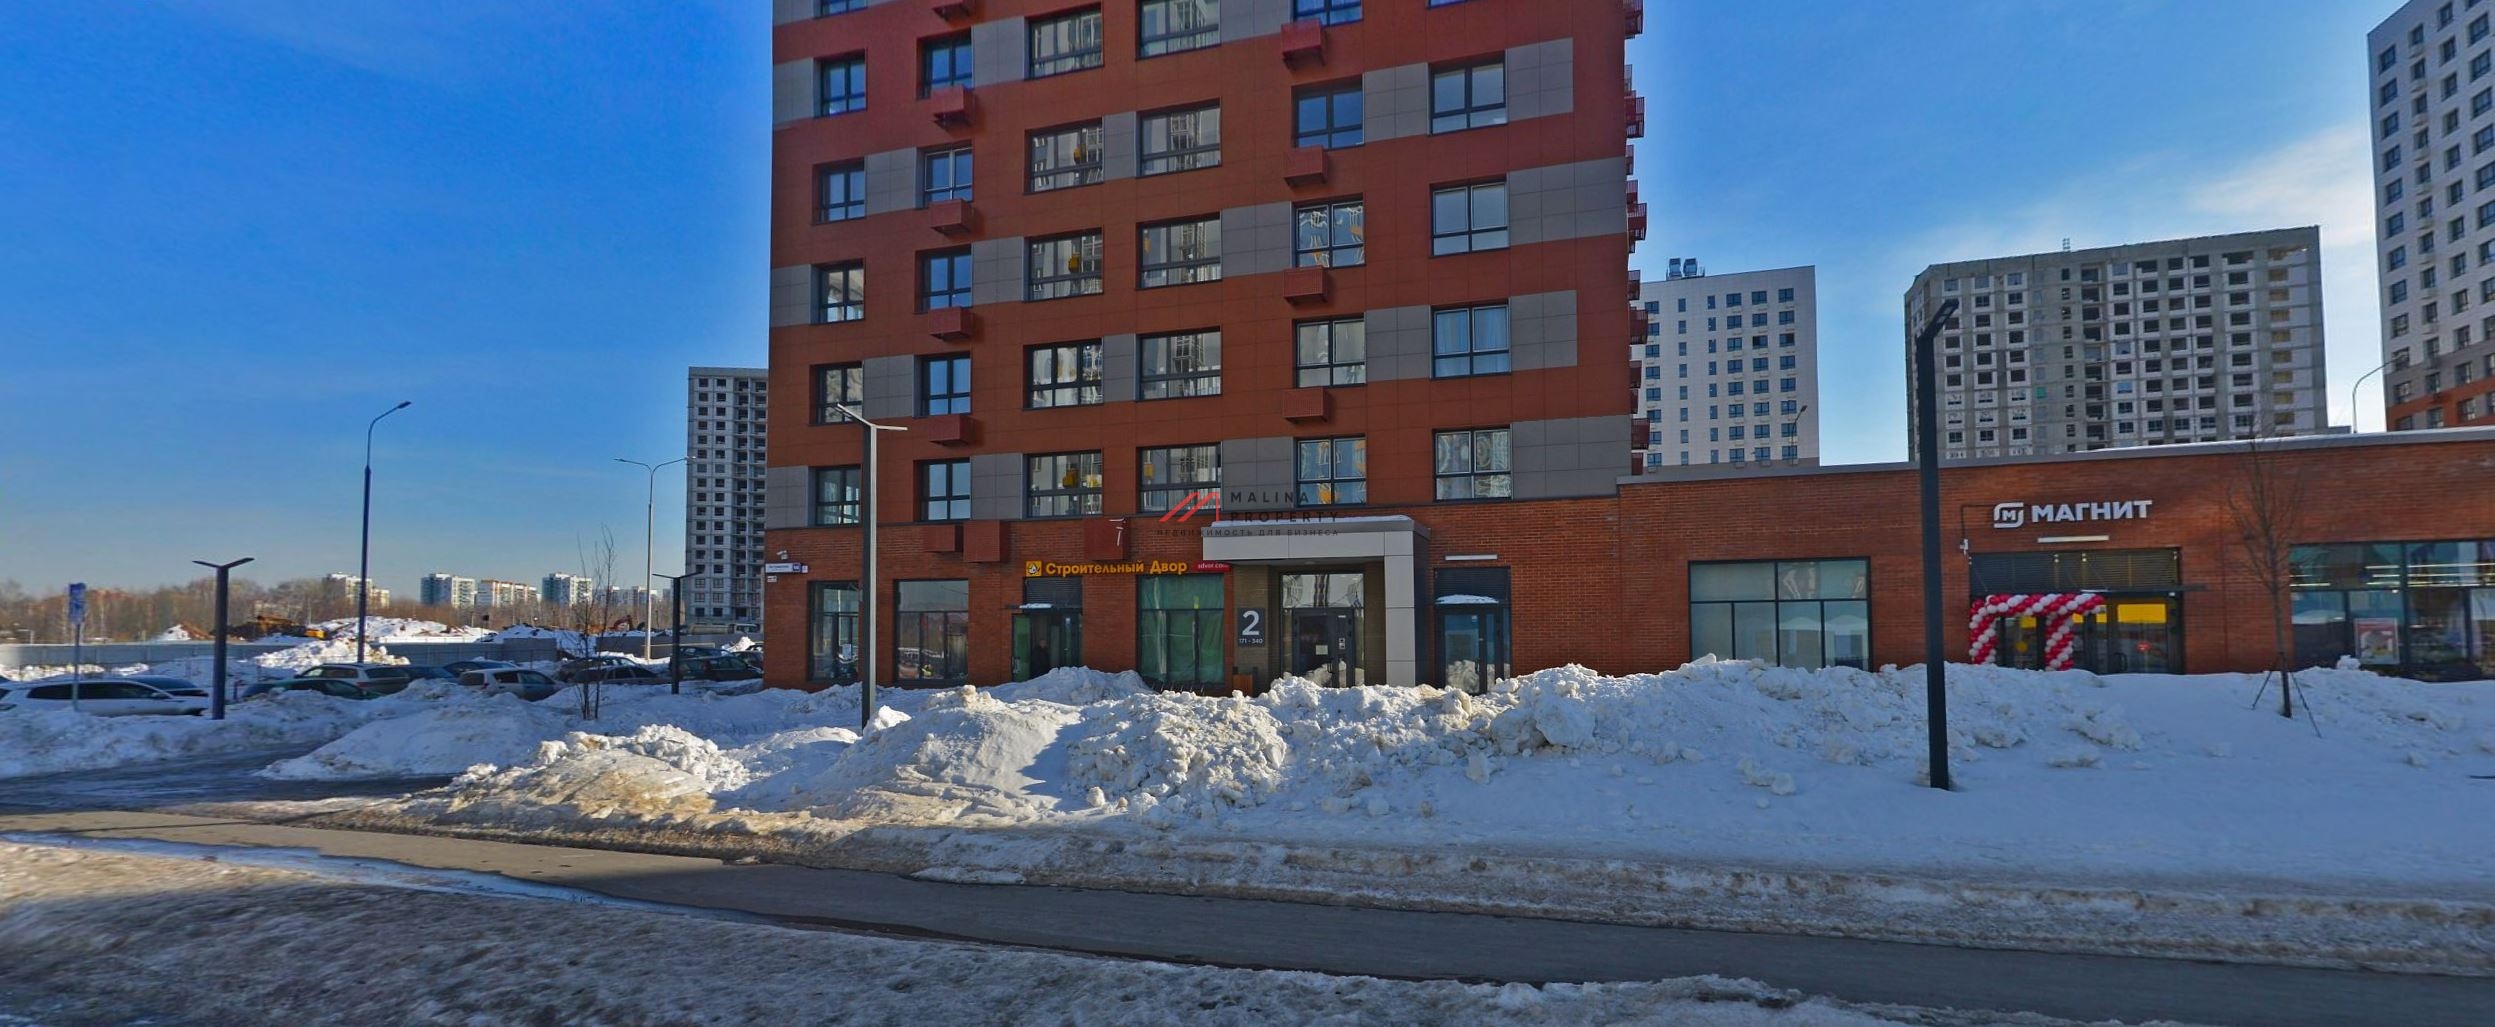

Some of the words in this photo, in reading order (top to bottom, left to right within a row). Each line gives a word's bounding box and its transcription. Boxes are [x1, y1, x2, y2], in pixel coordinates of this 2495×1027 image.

[2031, 500, 2153, 523] МАГНИТ
[1045, 560, 1144, 577] Строительный
[1150, 560, 1188, 576] Двор
[1242, 610, 1260, 636] 2
